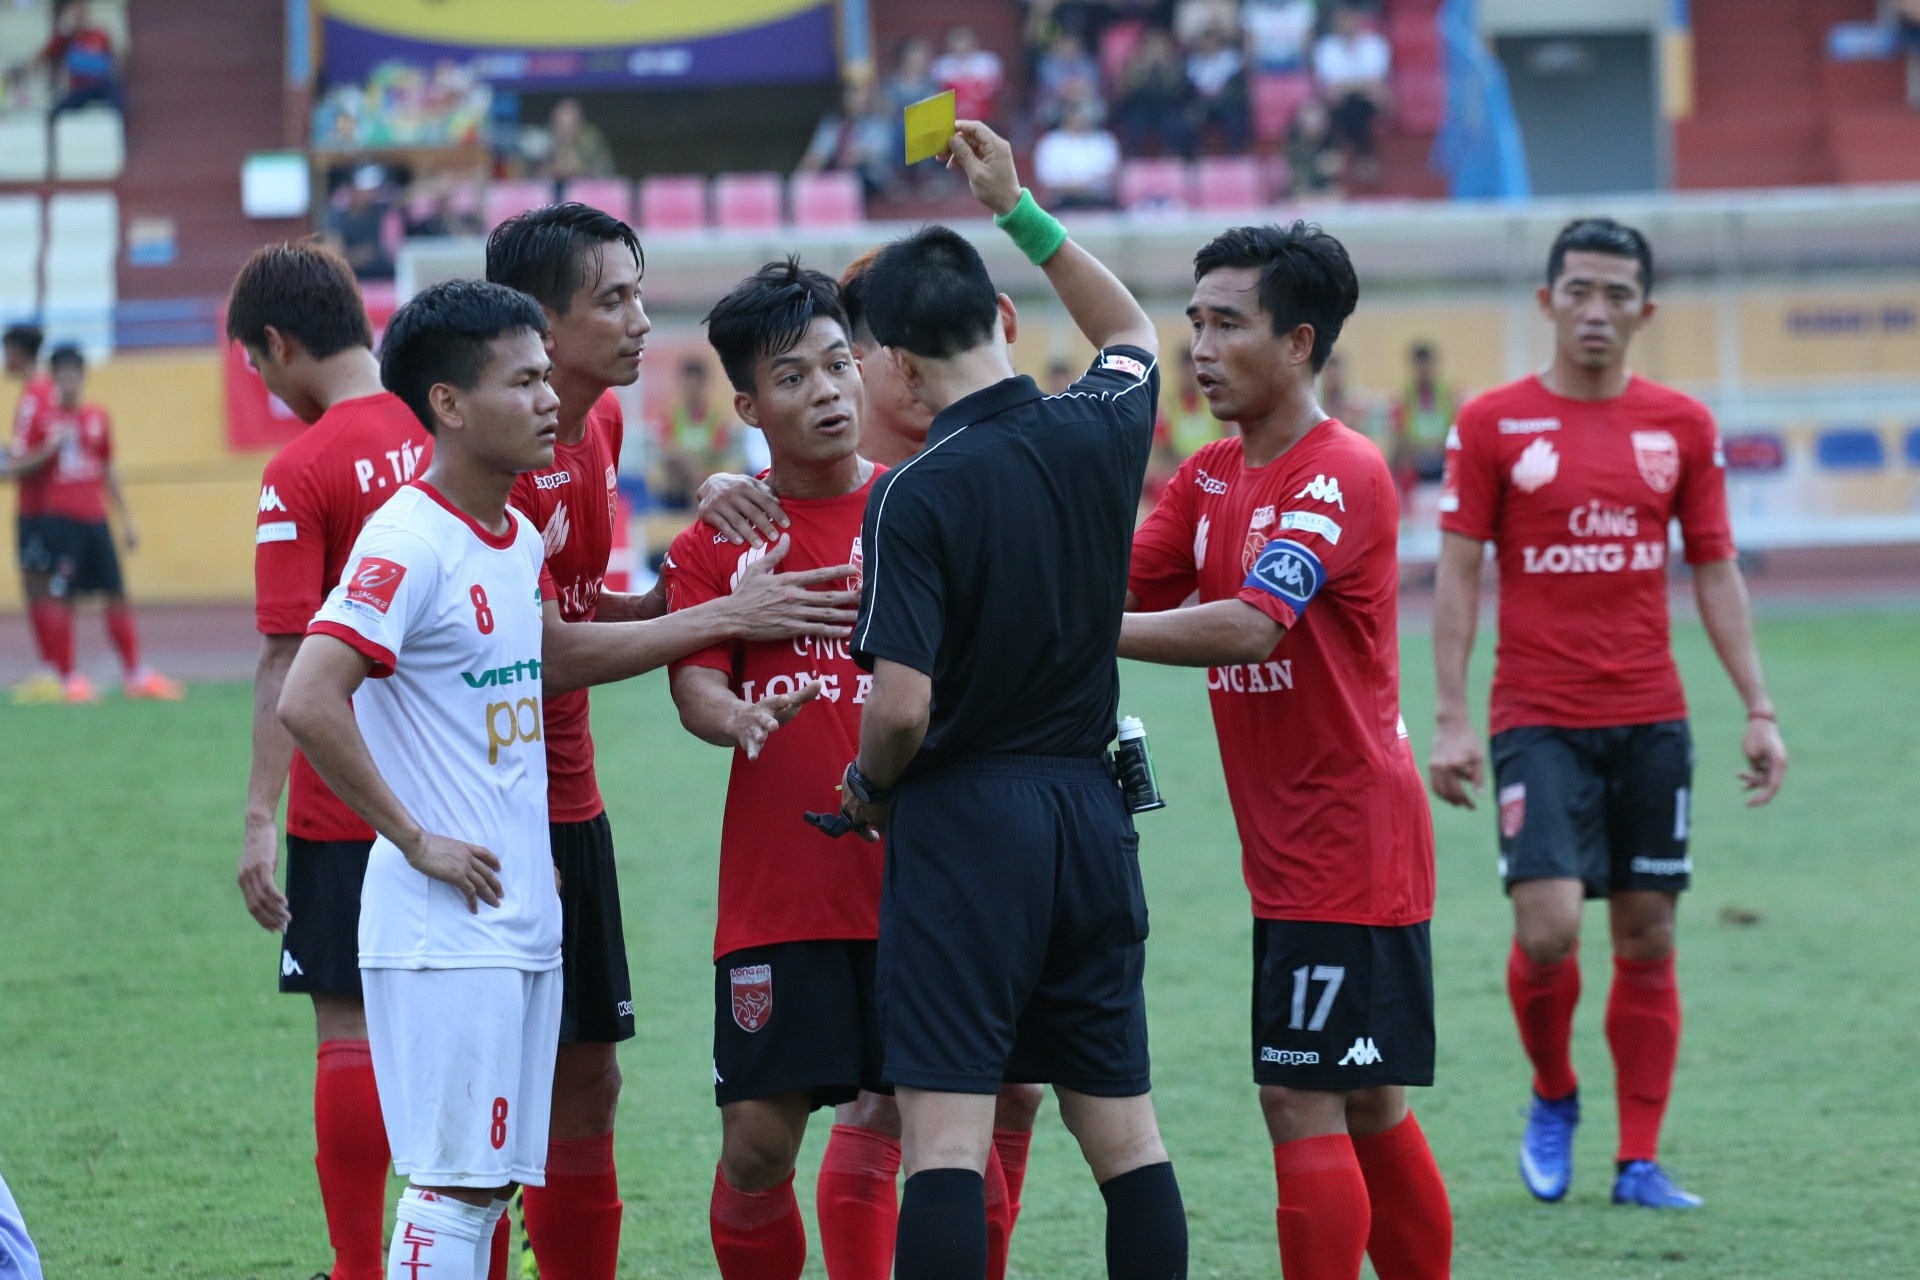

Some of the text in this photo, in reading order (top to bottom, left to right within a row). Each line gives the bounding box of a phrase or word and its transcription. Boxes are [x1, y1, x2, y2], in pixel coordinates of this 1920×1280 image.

[1523, 543, 1625, 573] LONG
[469, 584, 495, 635] 8
[853, 674, 874, 703] A
[1247, 659, 1294, 693] AN
[1288, 965, 1345, 1031] 17
[1261, 1046, 1319, 1065] Kappa
[490, 1097, 508, 1149] 8
